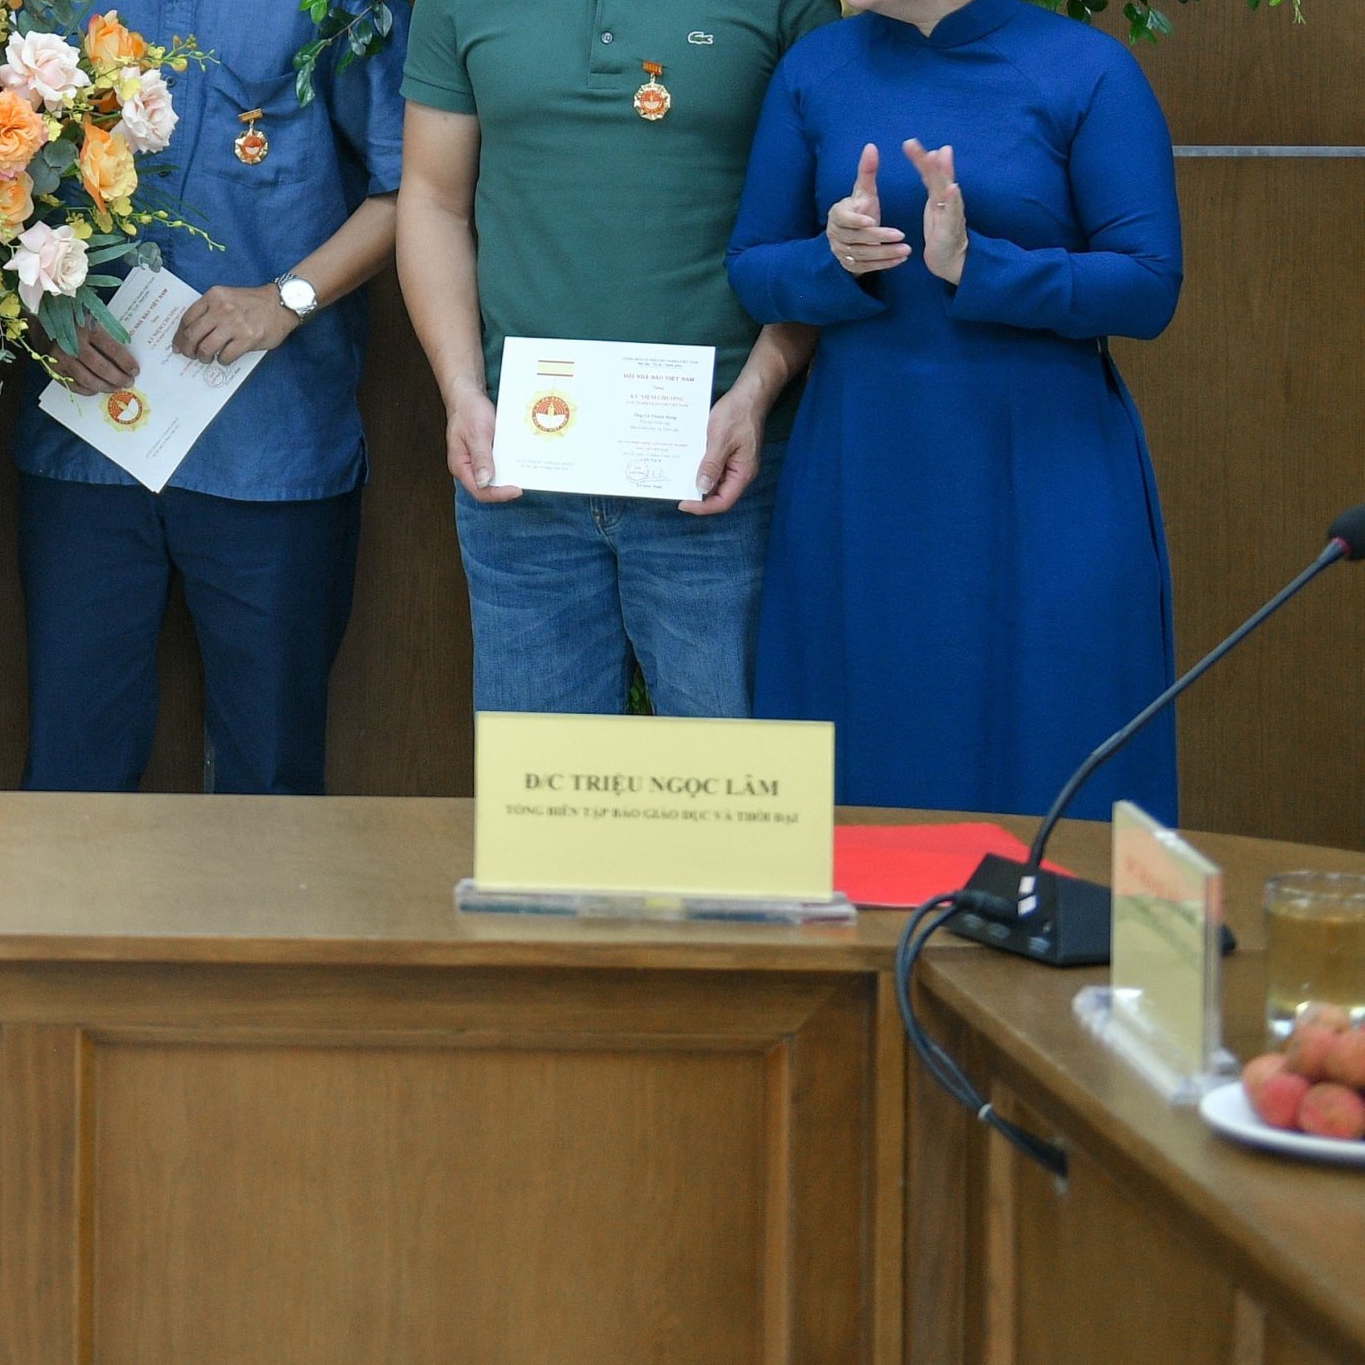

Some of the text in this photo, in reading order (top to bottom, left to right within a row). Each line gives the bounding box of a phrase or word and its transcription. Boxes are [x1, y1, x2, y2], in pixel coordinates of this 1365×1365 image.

[524, 772, 565, 792] Đ/C
[569, 773, 643, 797] TRIỆU
[648, 776, 720, 799] NGỌC
